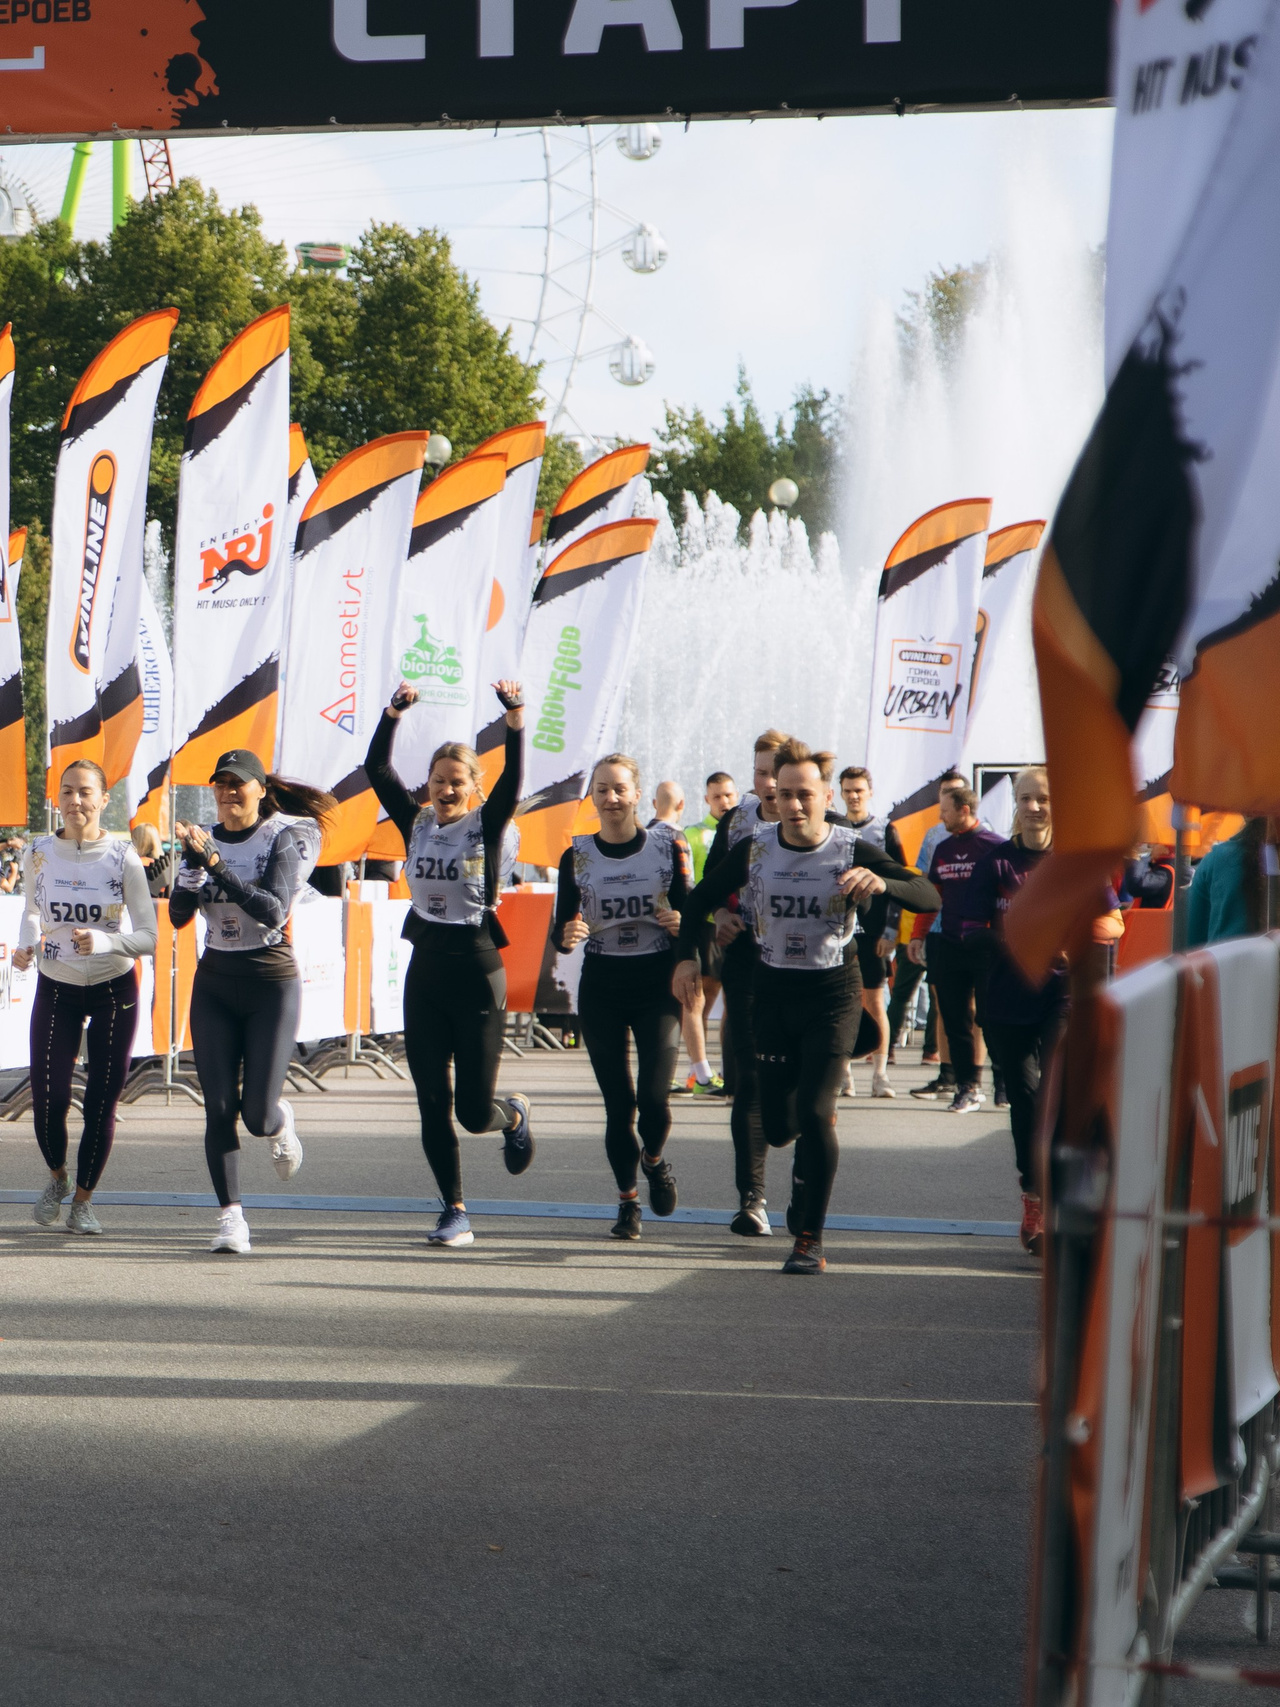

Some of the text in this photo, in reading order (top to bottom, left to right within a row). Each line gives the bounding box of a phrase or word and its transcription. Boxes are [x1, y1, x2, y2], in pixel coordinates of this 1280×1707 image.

[200, 518, 260, 549] ENERGY
[79, 498, 108, 657] WINLINE
[197, 600, 210, 609] HIT
[212, 598, 238, 609] MUSIC
[239, 597, 259, 607] ONLY
[338, 567, 364, 689] ametist
[402, 655, 463, 678] bionova
[909, 667, 938, 677] ГОНКА
[906, 676, 940, 686] ГЕРОЕВ
[884, 683, 963, 720] URBAN
[415, 857, 459, 881] 5216
[50, 901, 102, 923] 5209
[601, 894, 654, 920] 5205
[770, 895, 822, 919] 5214
